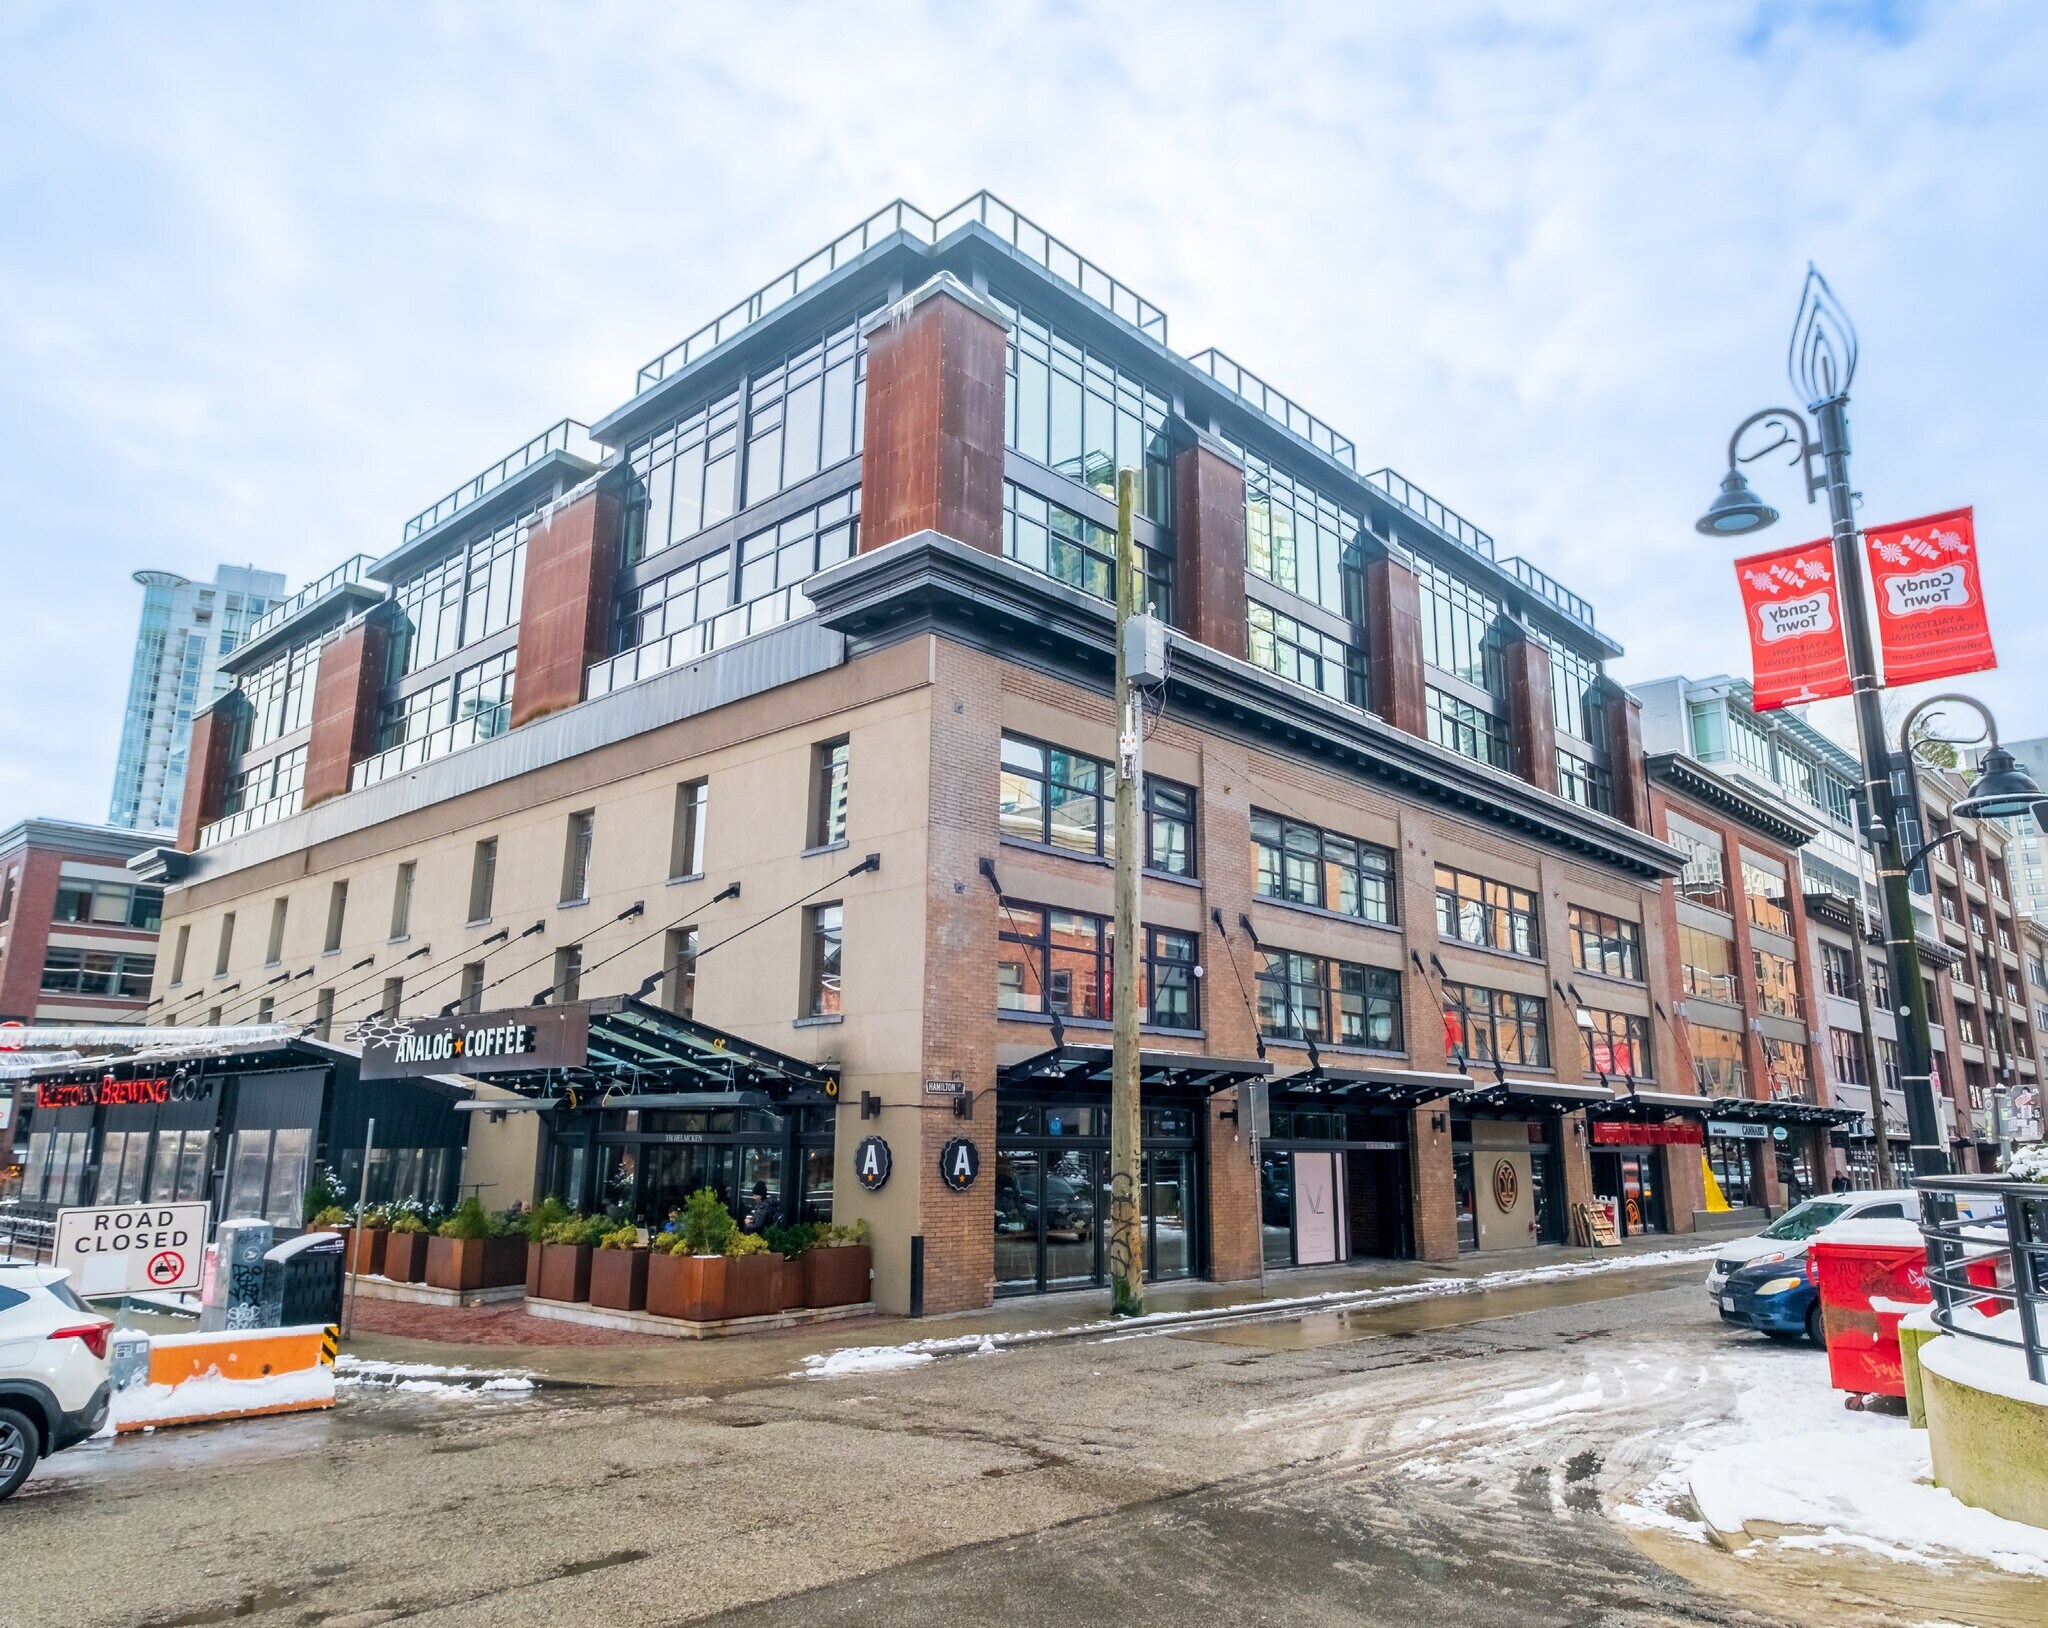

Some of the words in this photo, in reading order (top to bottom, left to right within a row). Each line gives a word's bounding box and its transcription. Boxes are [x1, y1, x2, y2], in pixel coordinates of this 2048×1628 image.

[395, 1033, 453, 1063] ANALOG
[465, 1025, 527, 1058] COFFEE
[101, 1077, 168, 1104] BREWING
[929, 1082, 956, 1091] HAMILTON
[863, 1145, 878, 1174] A
[954, 1146, 971, 1175] A
[94, 1211, 173, 1231] ROAD
[75, 1231, 188, 1253] CLOSED
